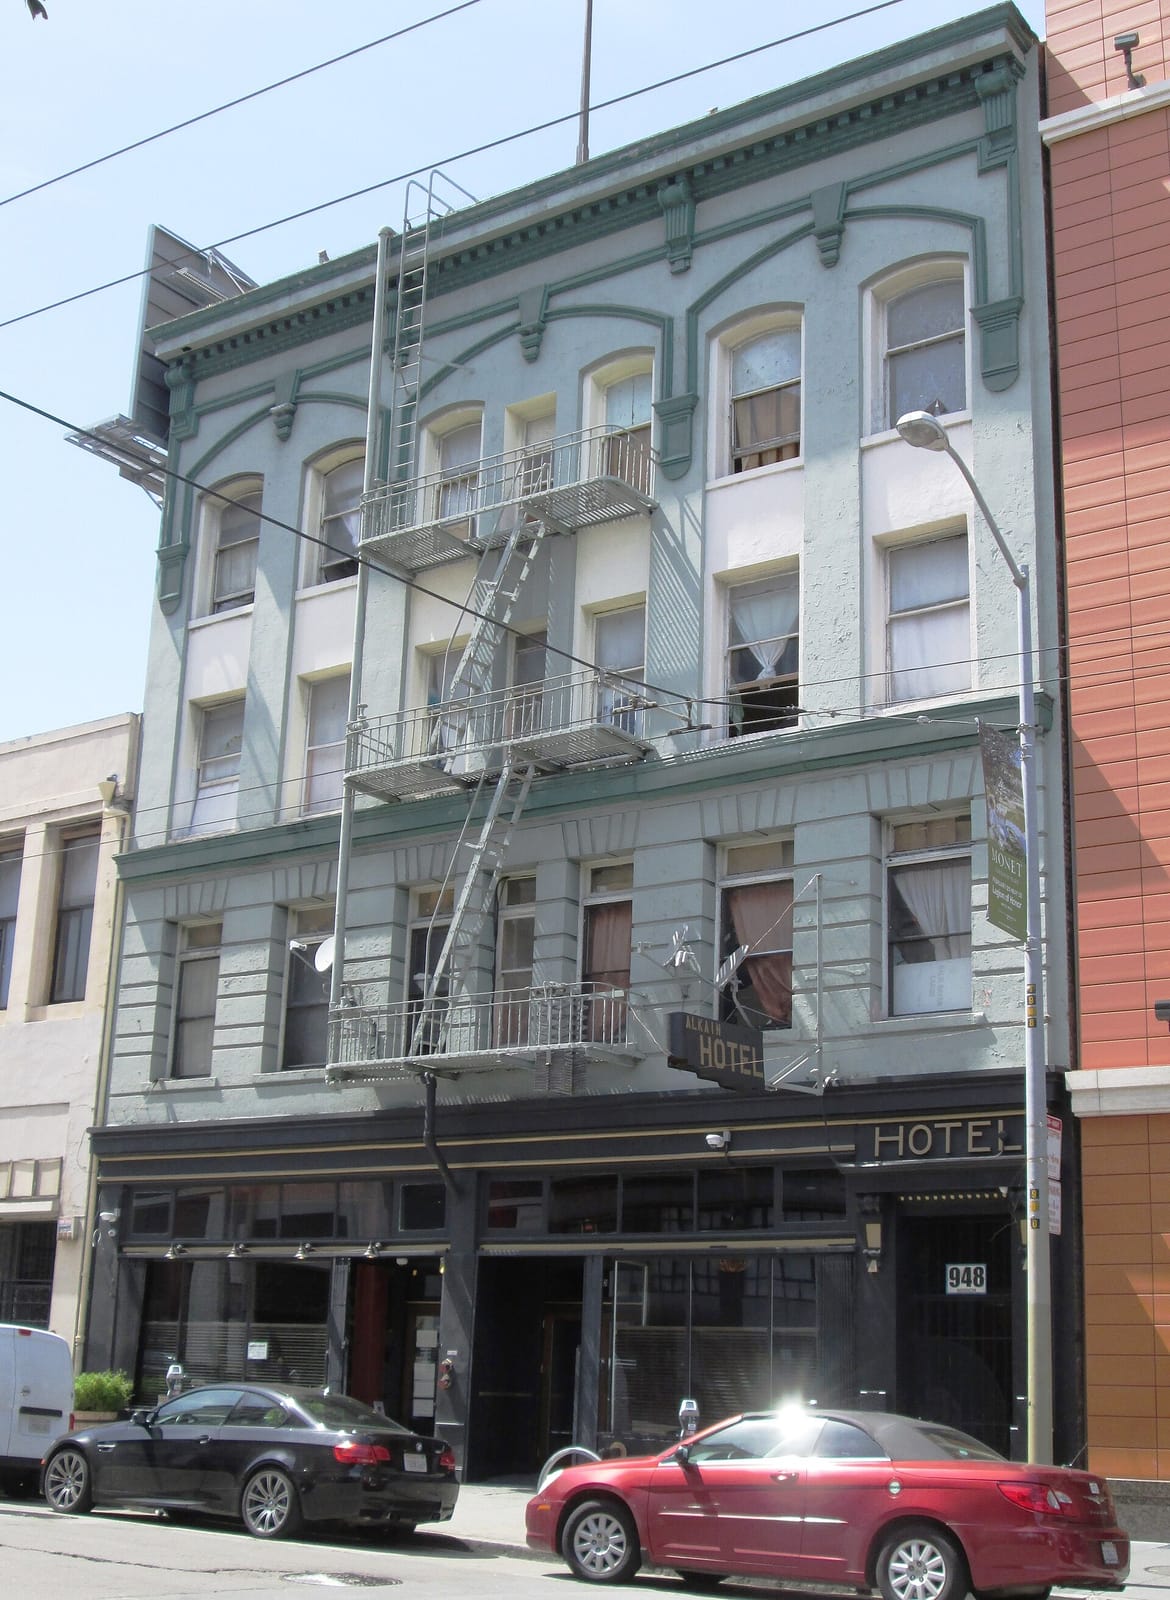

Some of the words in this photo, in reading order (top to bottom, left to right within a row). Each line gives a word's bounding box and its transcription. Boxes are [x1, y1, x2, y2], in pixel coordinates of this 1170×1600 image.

[991, 847, 1022, 877] MONET
[699, 1034, 763, 1079] HOTEL
[874, 1119, 1023, 1157] HOTEL
[949, 1266, 985, 1288] 948
